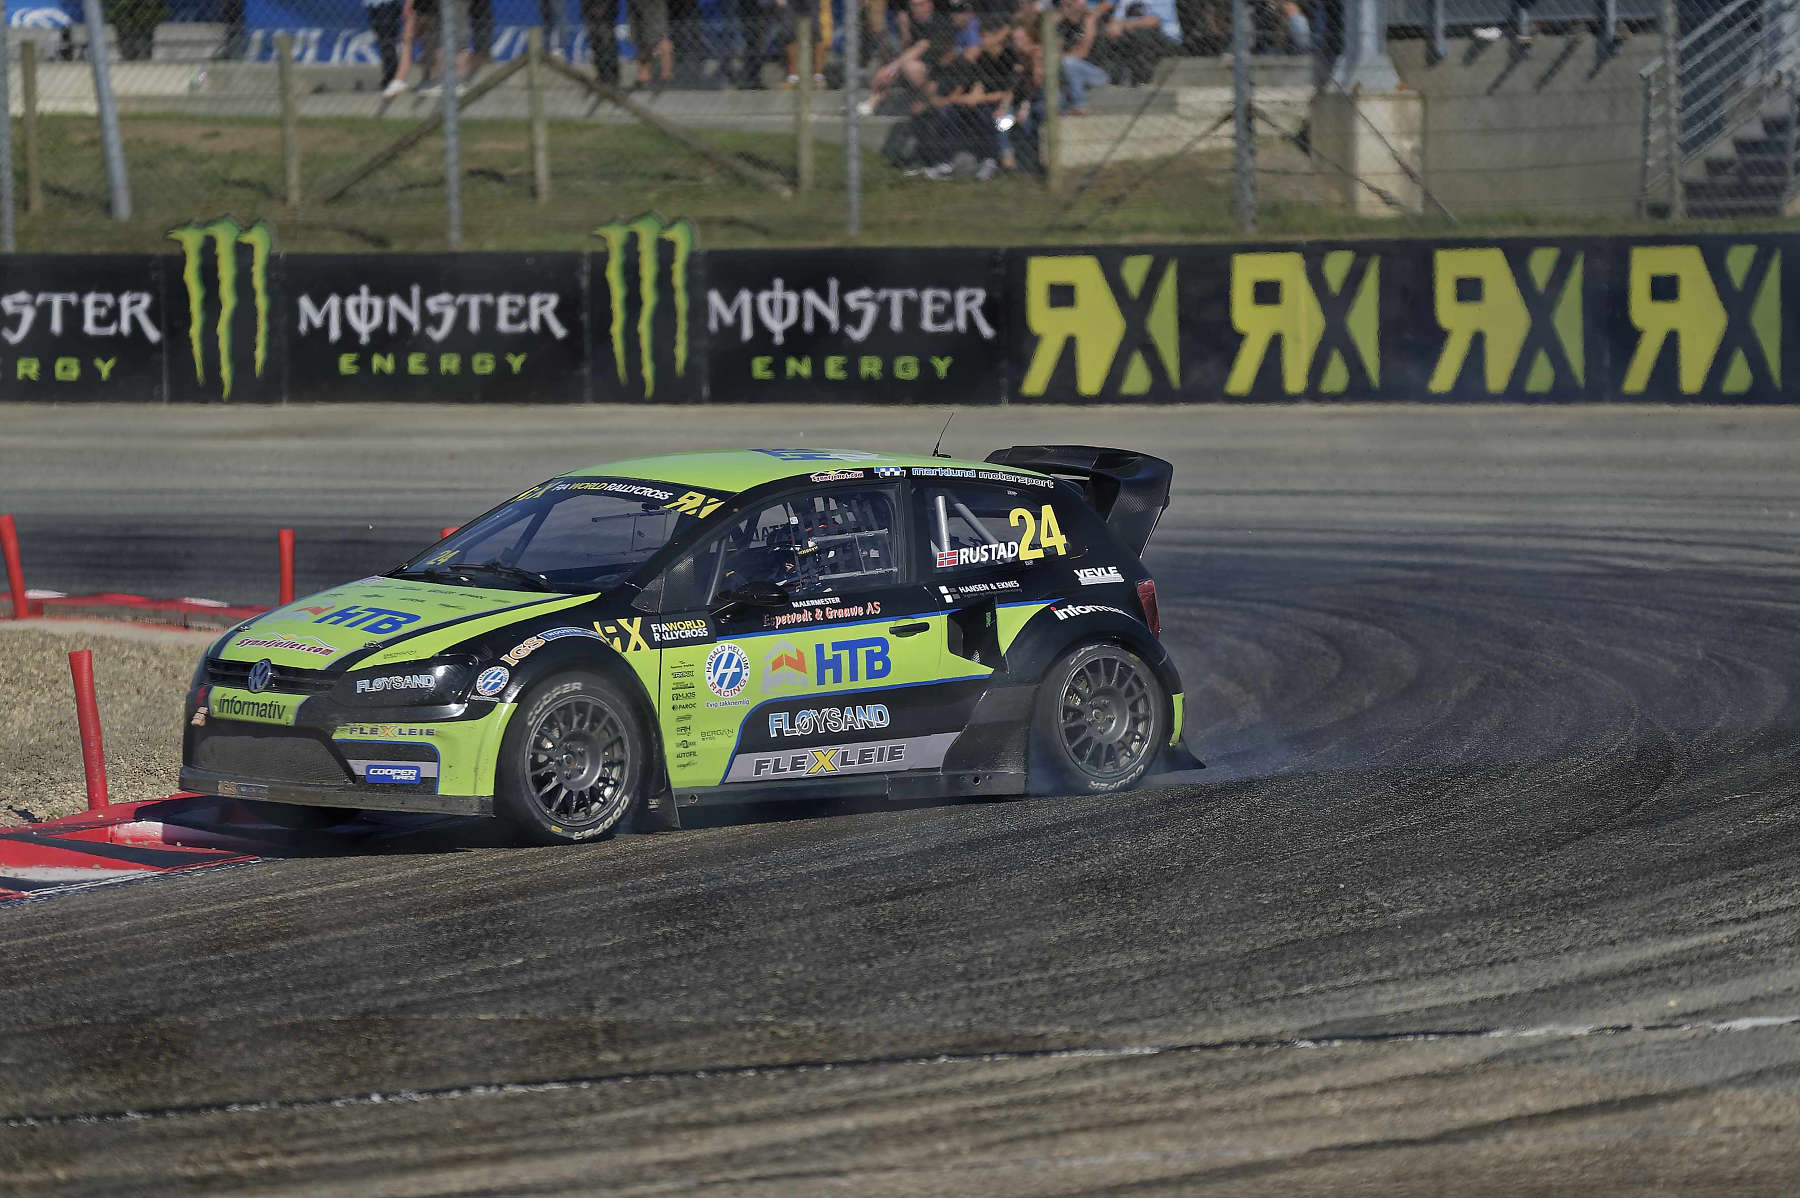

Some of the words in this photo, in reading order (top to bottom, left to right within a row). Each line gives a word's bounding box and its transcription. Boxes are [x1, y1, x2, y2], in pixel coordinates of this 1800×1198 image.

[299, 284, 568, 345] MONSTER
[707, 277, 996, 345] MONSTER
[0, 357, 117, 381] RGY
[338, 353, 528, 376] ENERGY
[752, 355, 953, 380] ENERGY
[911, 467, 977, 479] marklund
[979, 472, 1054, 488] motorsport
[568, 482, 608, 491] WORLD
[604, 482, 676, 500] RALLYCROSS
[1008, 504, 1068, 562] 24
[959, 541, 1019, 565] RUSTAD
[958, 583, 990, 593] HANSEN
[996, 580, 1020, 589] EKNES
[791, 597, 841, 608] MALERMESTER
[815, 608, 824, 621] &
[866, 601, 881, 615] AS
[312, 605, 421, 634] HTB
[653, 627, 709, 643] RALLYCROSS
[500, 635, 545, 667] IGS
[706, 645, 726, 673] HARALD
[727, 645, 750, 671] HELLUM
[815, 637, 892, 686] HTB
[357, 674, 436, 694] FLØYSAND
[709, 678, 747, 697] RACING
[218, 693, 287, 720] informativ
[350, 723, 436, 738] FLEXLEIE
[768, 703, 891, 739] FLØYSAND
[753, 743, 907, 777] FLEXLEIE
[369, 768, 418, 777] COOPER
